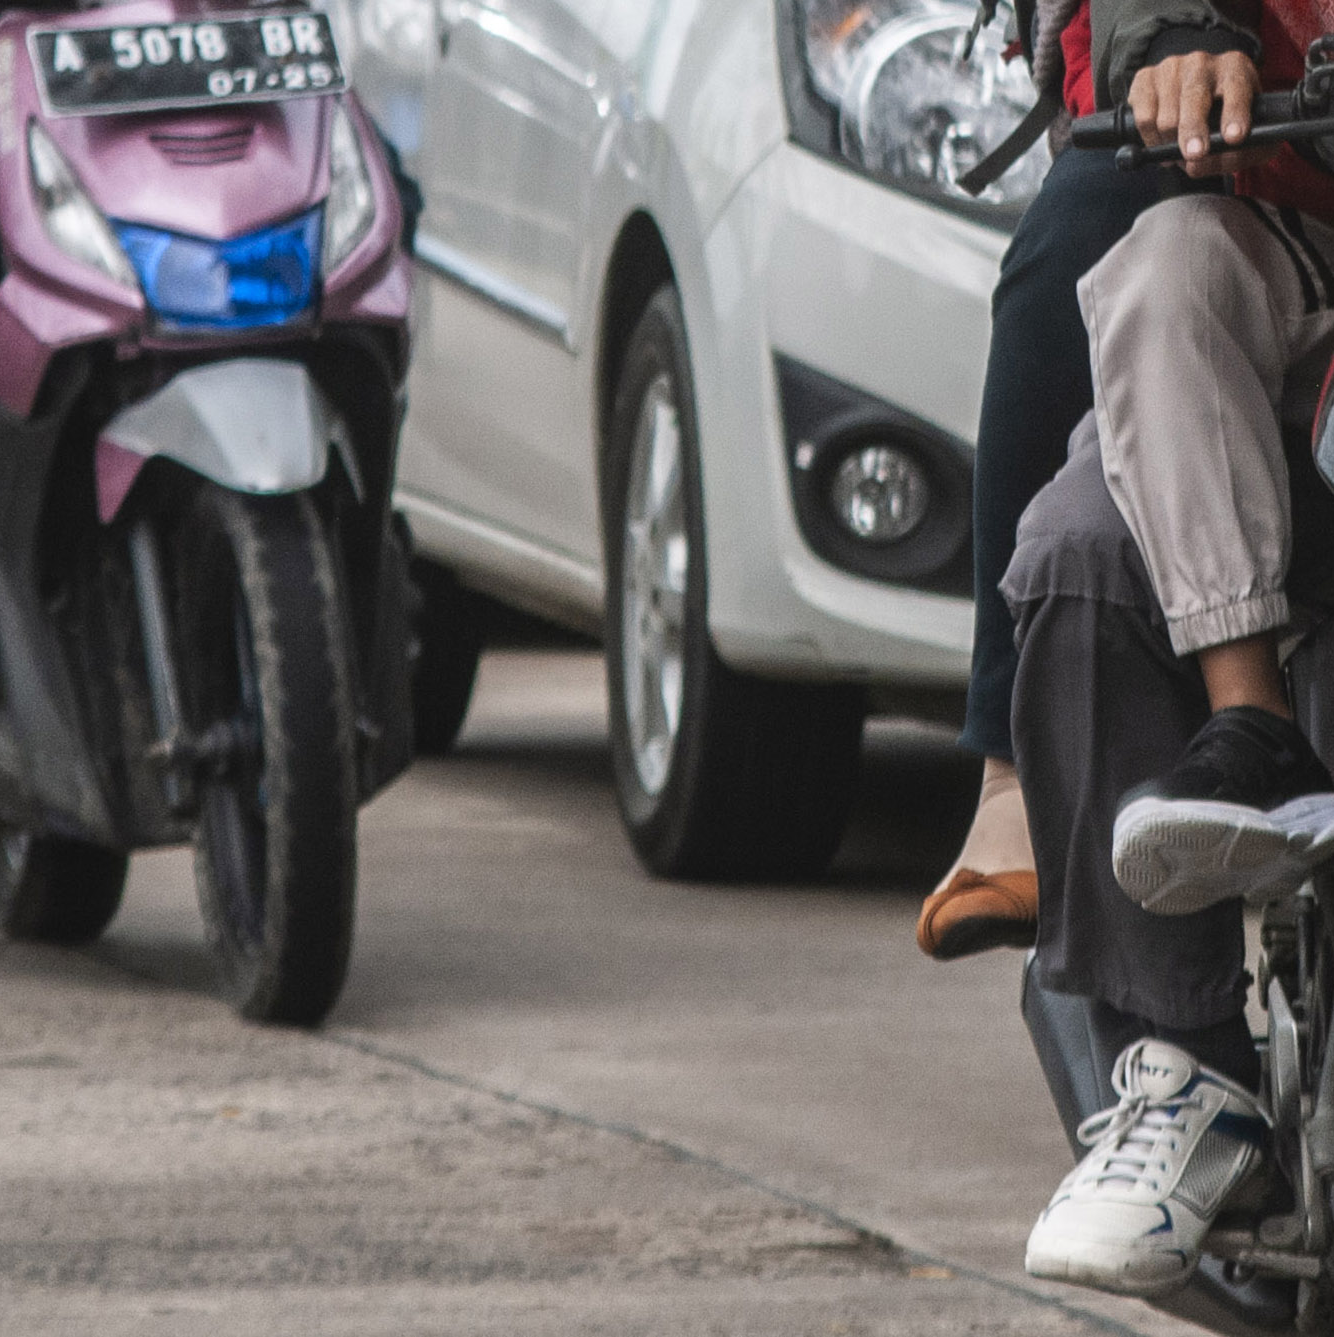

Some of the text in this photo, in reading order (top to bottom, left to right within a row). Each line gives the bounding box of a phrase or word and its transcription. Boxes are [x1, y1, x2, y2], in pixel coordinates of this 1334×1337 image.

[53, 15, 323, 73] A 5078 BR
